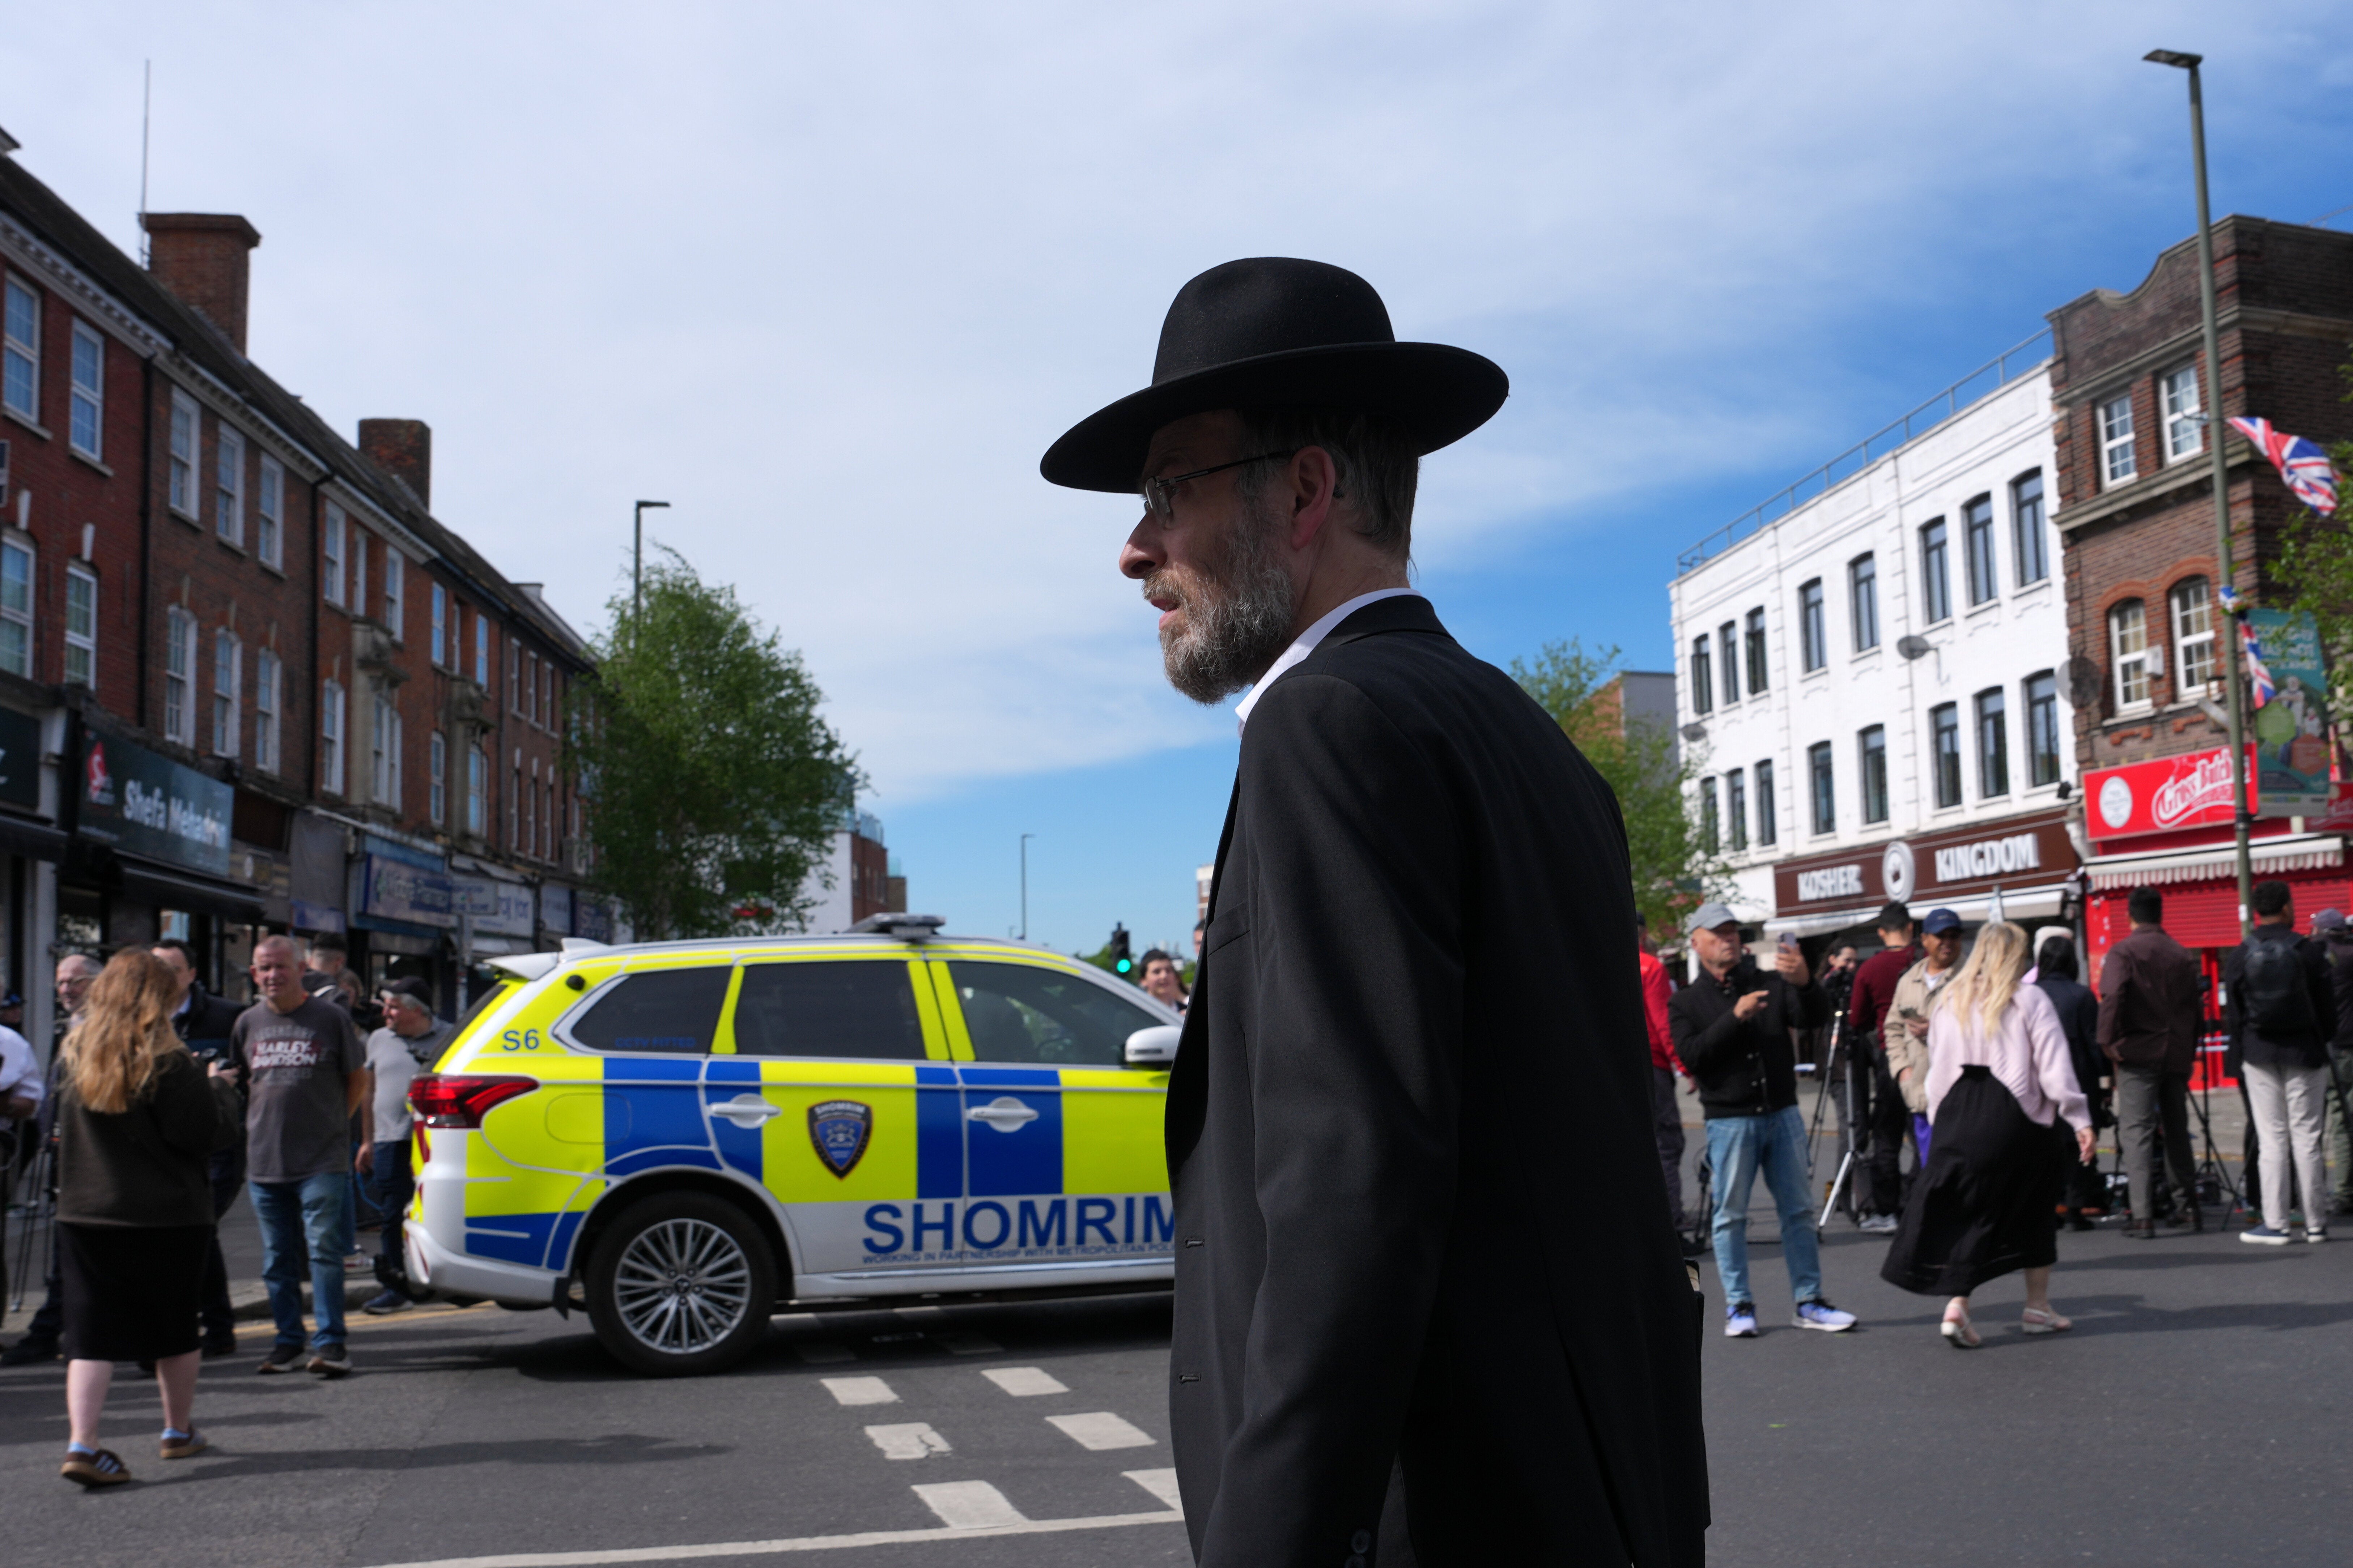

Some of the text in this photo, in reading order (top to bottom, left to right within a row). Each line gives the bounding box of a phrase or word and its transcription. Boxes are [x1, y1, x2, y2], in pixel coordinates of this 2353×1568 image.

[123, 779, 166, 831] Shefa
[1797, 832, 2040, 902] KOSHER KINGDOM
[502, 1029, 540, 1051] S6
[615, 1036, 696, 1048] CCTV FITTED
[252, 1053, 318, 1069] DAVIDSON
[862, 1196, 1175, 1254] SHOMRIM
[862, 1252, 921, 1264] WORKING
[923, 1252, 936, 1261] IN
[940, 1248, 1021, 1261] PARTNERSHIP
[1024, 1247, 1054, 1257] WITH
[1057, 1243, 1145, 1255] METROPOLITAN
